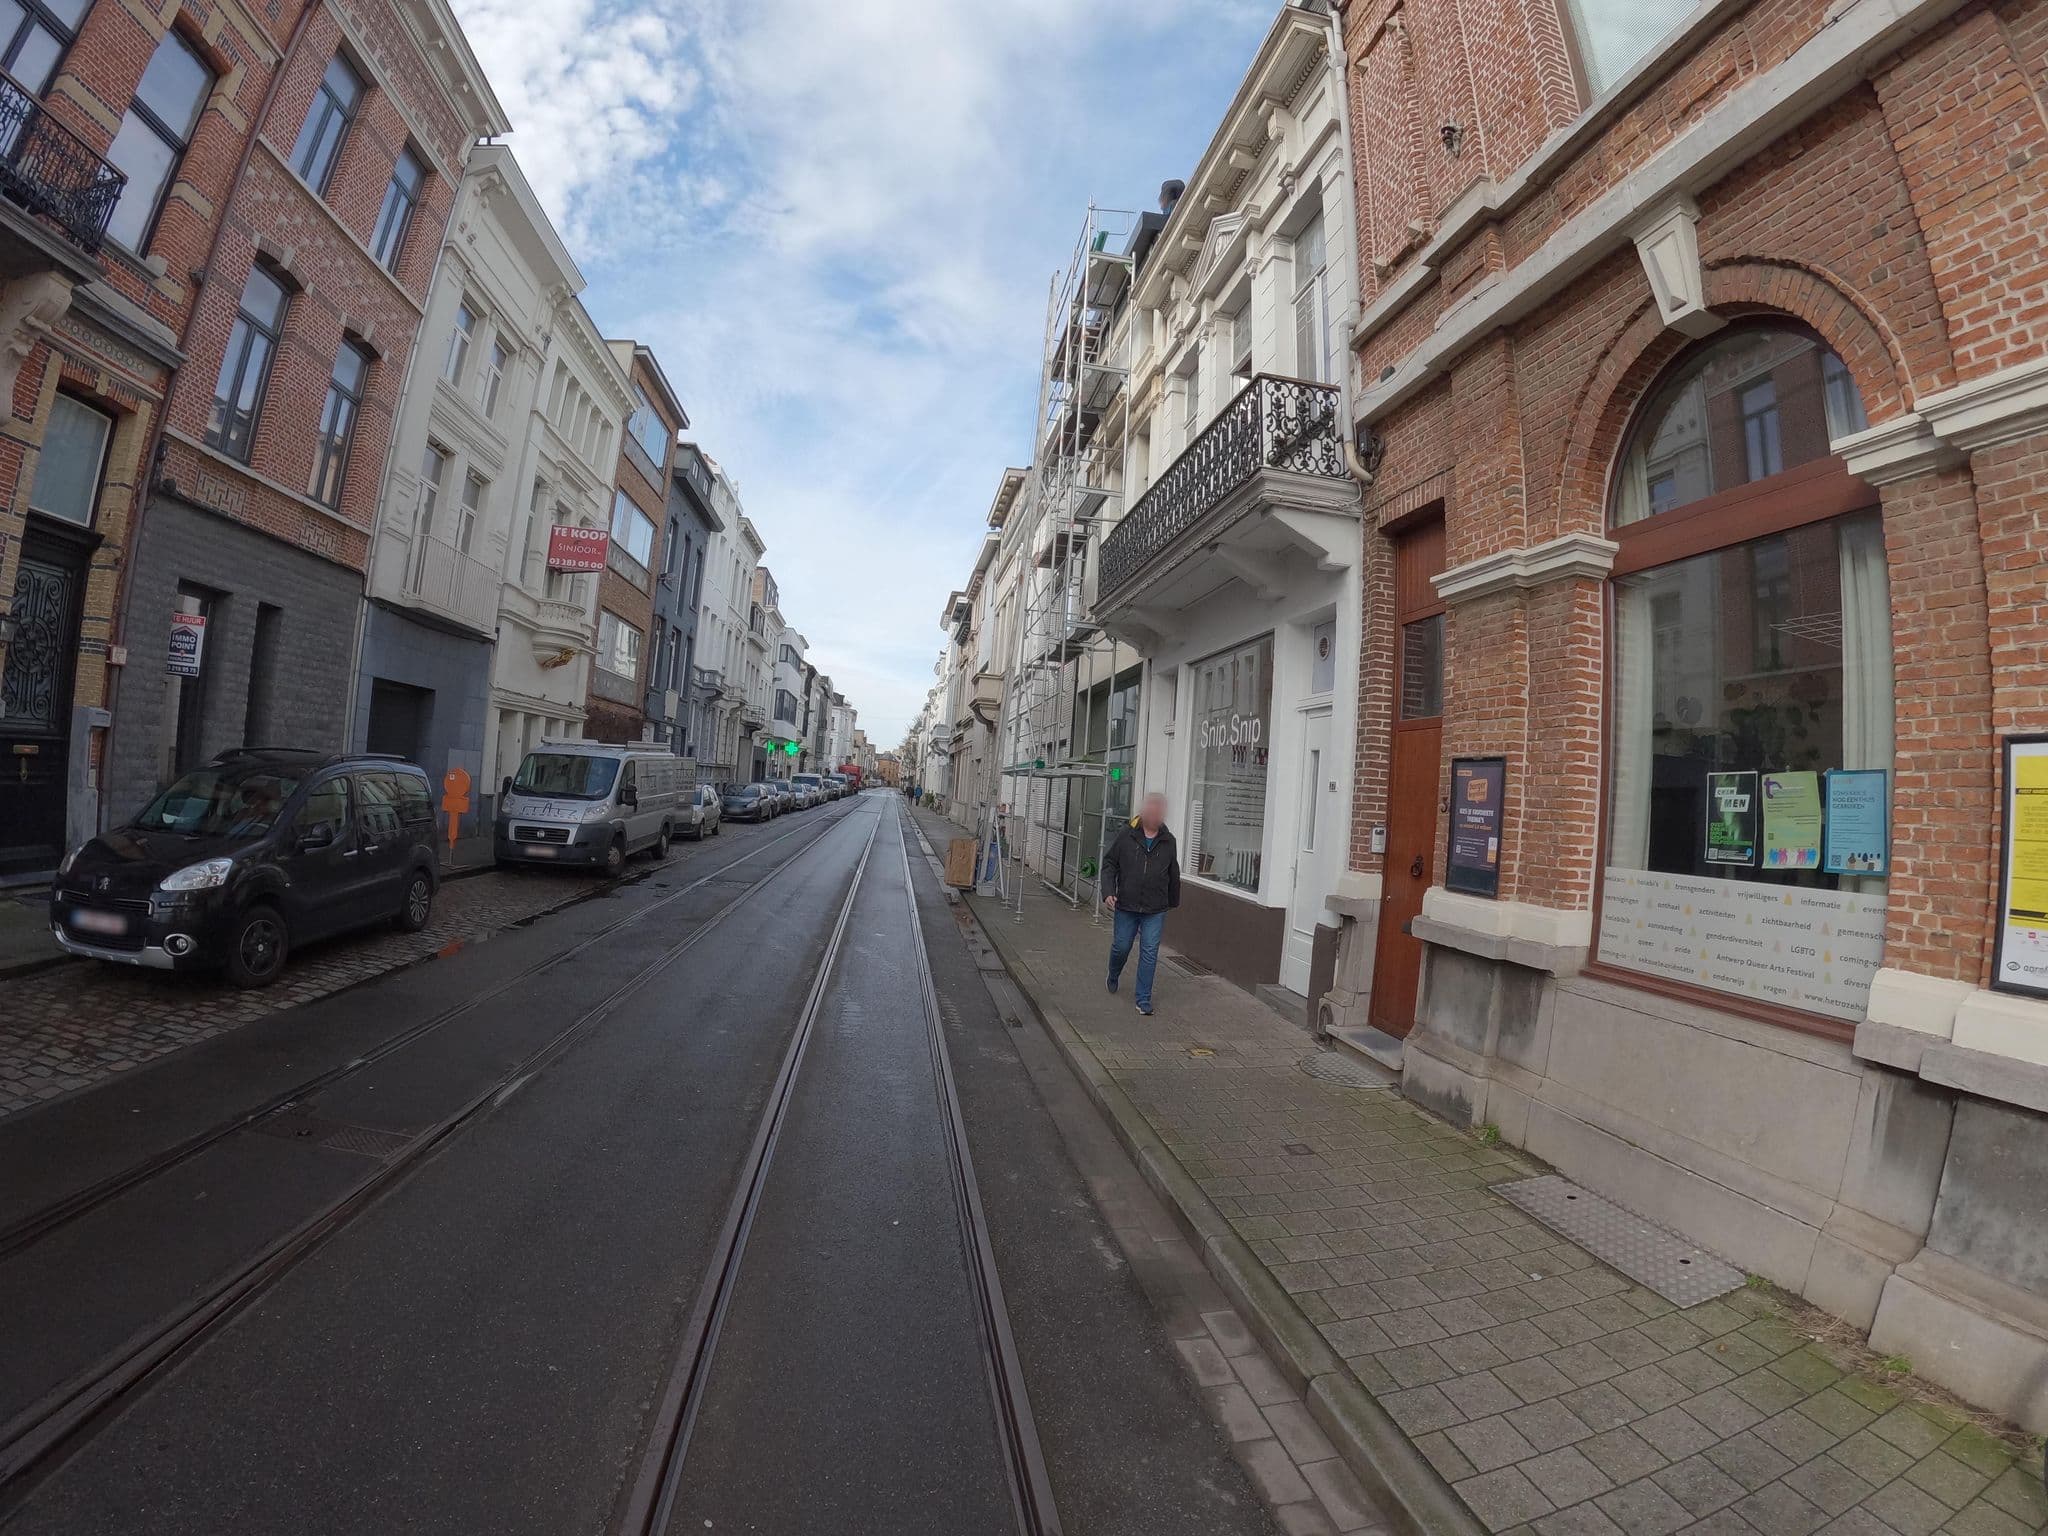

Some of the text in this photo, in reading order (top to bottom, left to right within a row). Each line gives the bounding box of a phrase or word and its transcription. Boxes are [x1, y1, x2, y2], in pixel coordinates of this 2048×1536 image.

[553, 527, 607, 540] TE KOOP
[558, 543, 597, 554] SINJOOR
[182, 616, 202, 624] HUUR
[172, 634, 196, 643] IMMO
[171, 642, 195, 650] POINT
[1723, 799, 1746, 808] MEN
[1675, 883, 1716, 895] transgenders
[1737, 891, 1778, 903] vrijwilligers
[1800, 898, 1841, 910] informatie
[1657, 902, 1680, 911] onthaal
[1699, 908, 1736, 919] activiteiten
[1762, 917, 1811, 930] zichtbaarheid
[1705, 932, 1763, 947] genderdiversiteit
[1791, 945, 1816, 957] LGBTQ
[1638, 939, 1655, 948] queer
[1674, 945, 1691, 955] pride
[1717, 953, 1744, 966] Antwerp
[1746, 958, 1768, 969] Queer
[1769, 963, 1784, 974] Arts
[1786, 967, 1815, 979] Festival
[1763, 983, 1787, 997] vragen
